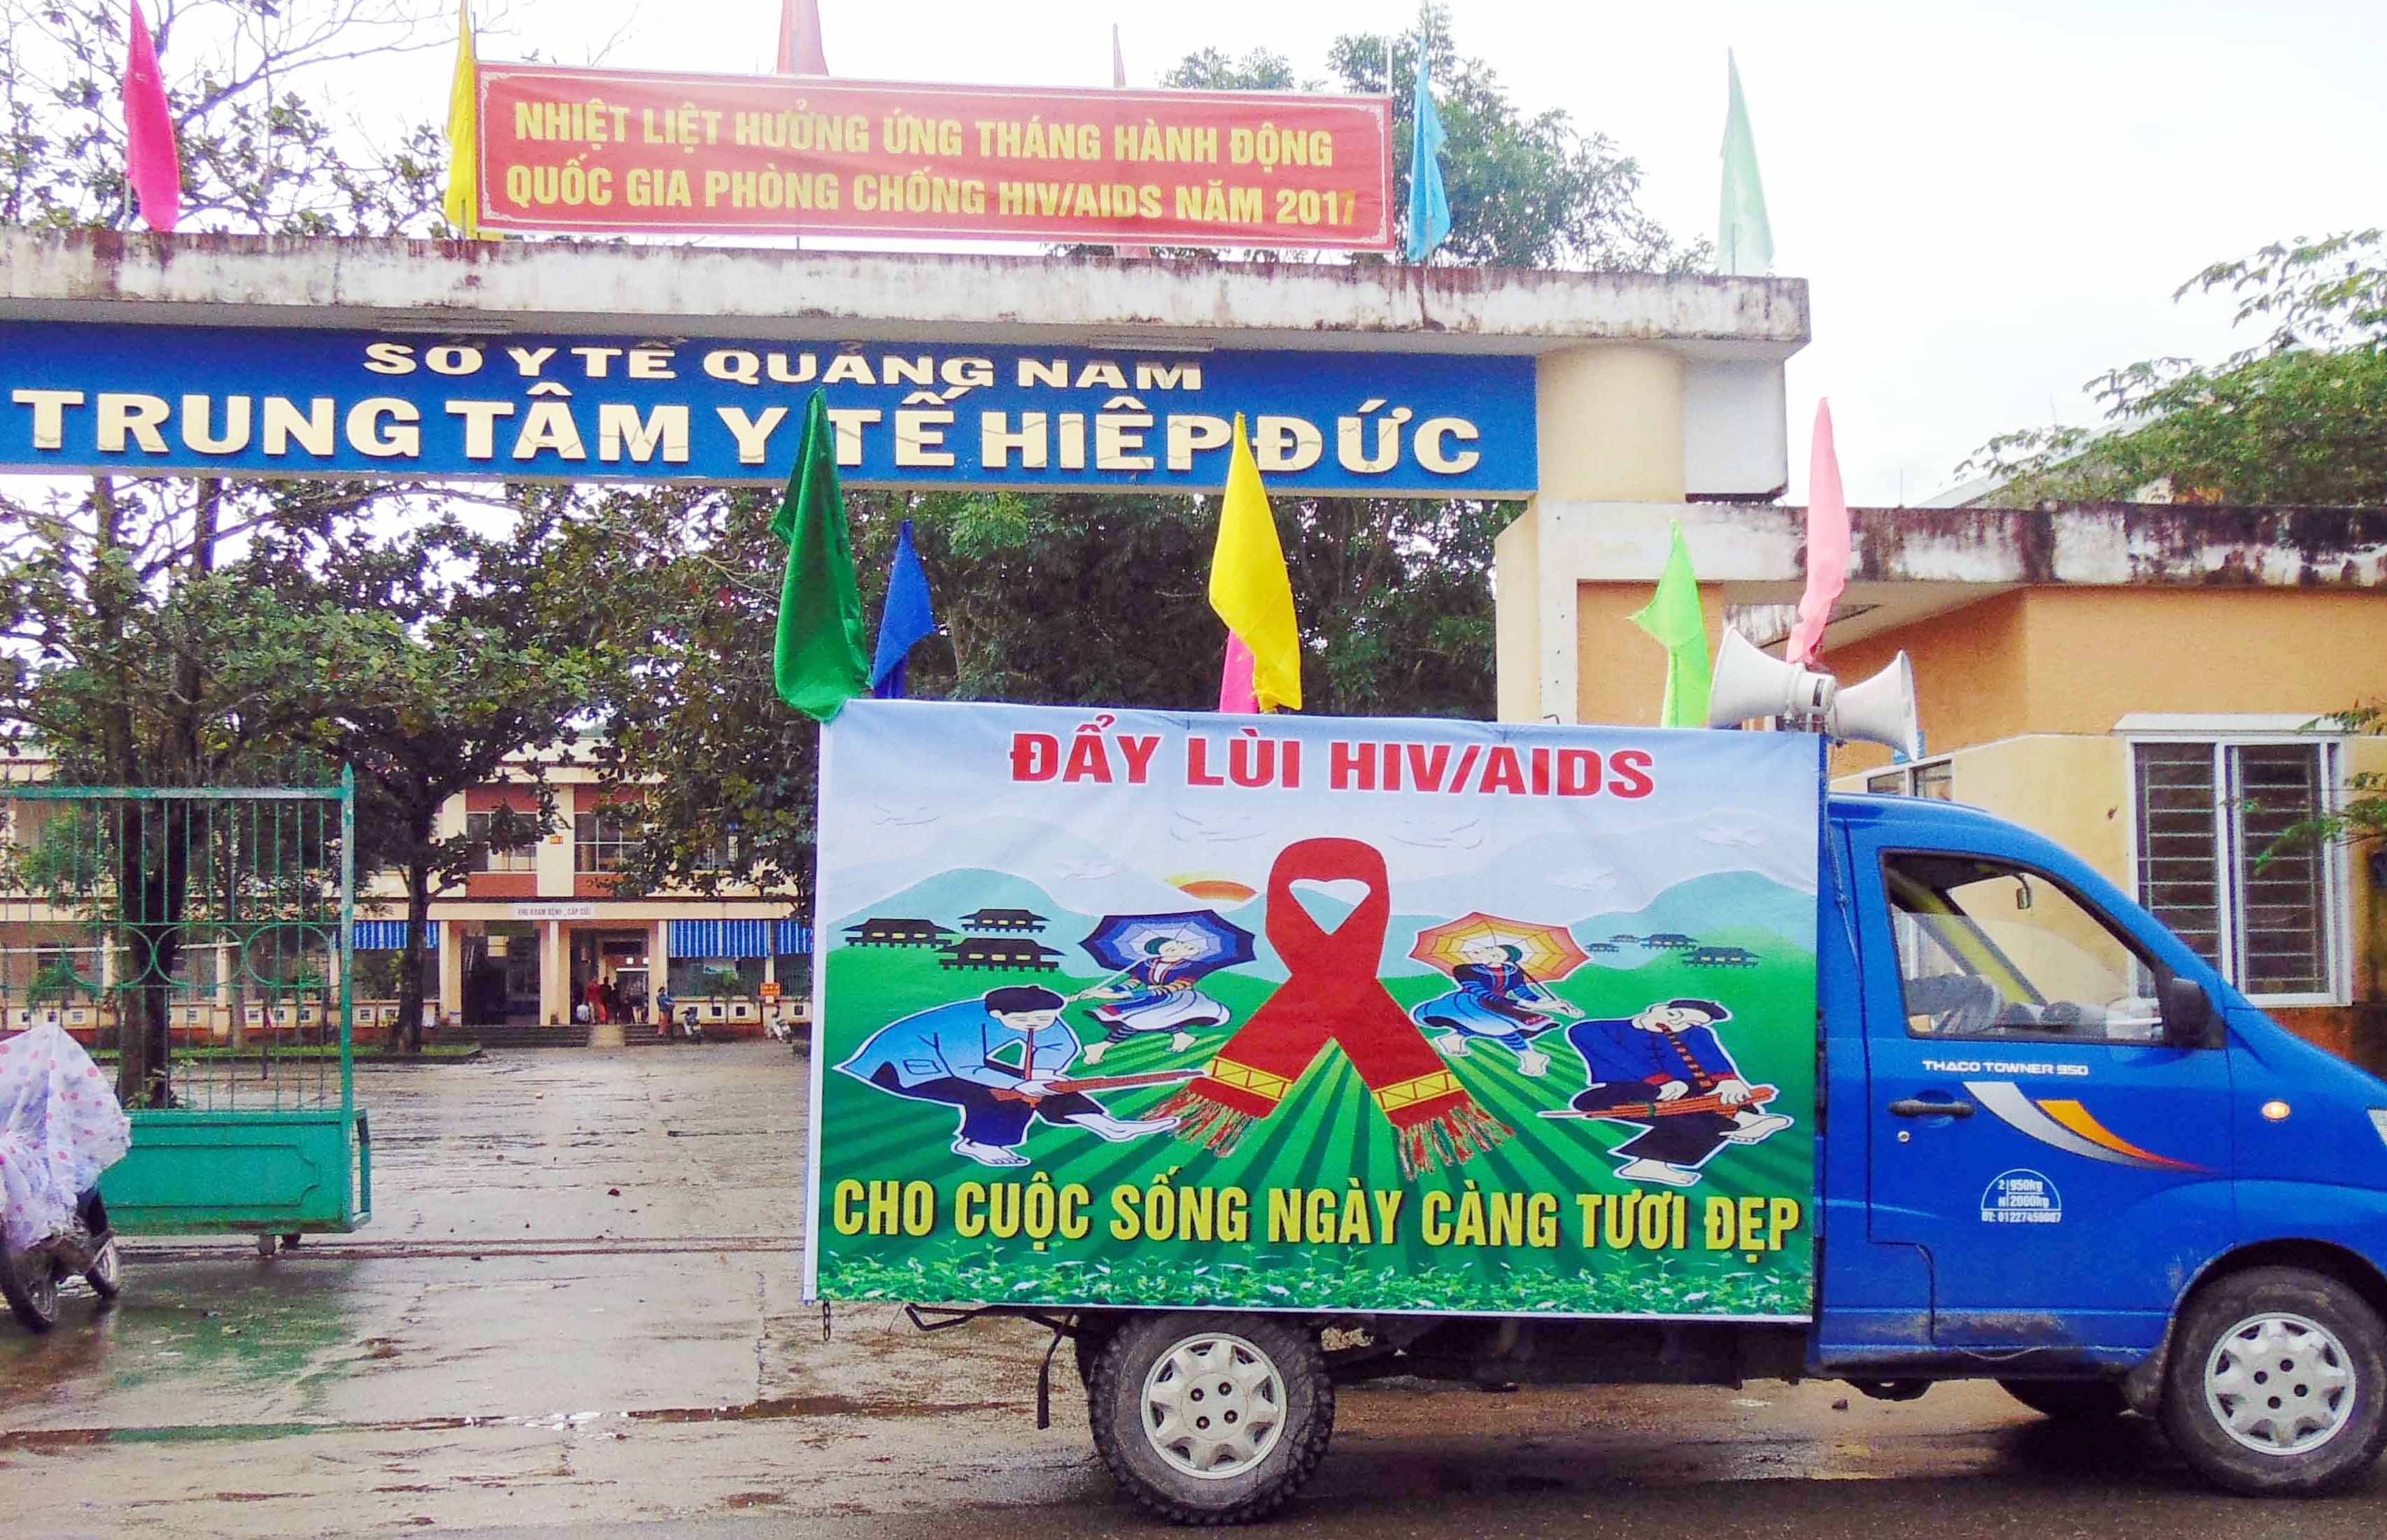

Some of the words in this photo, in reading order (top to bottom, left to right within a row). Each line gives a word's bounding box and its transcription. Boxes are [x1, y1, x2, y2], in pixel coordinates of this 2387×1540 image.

[514, 97, 630, 151] NHIỆT
[643, 101, 722, 153] LIỆT
[735, 99, 868, 153] HƯỞNG
[884, 107, 963, 157] ỨNG
[975, 115, 1101, 162] THÁNG
[1114, 117, 1220, 164] HÀNH
[1230, 122, 1333, 174] ĐỘNG
[507, 153, 613, 208] QUỐC
[627, 168, 692, 208] GIA
[704, 163, 840, 210] PHÒNG
[853, 166, 987, 214] CHỐNG
[998, 182, 1163, 220] HIV/AIDS
[1175, 180, 1263, 224] NĂM
[1276, 190, 1356, 225] 2017
[507, 347, 557, 376] Y
[1017, 358, 1203, 390] NAM
[11, 389, 420, 457] TRUNG
[445, 383, 690, 463] TÂM
[715, 407, 788, 464] Y
[828, 387, 972, 467] TẾ
[1252, 399, 1480, 474] ĐỨC
[1009, 715, 1161, 782] ĐẨY
[1187, 729, 1301, 789] LÙI
[1330, 741, 1655, 799] HIV/AIDS
[1922, 1060, 1981, 1072] THACO
[1982, 1062, 2054, 1074] TOWNER
[2057, 1064, 2089, 1076] 950
[833, 1179, 935, 1235] CHO
[954, 1171, 1091, 1251] CUỘC
[1108, 1165, 1247, 1242] SỐNG
[1267, 1177, 1403, 1245] NGÀY
[1421, 1181, 1559, 1248] CÀNG
[1576, 1190, 1686, 1250] TƯƠI
[1704, 1197, 1801, 1264] ĐẸP
